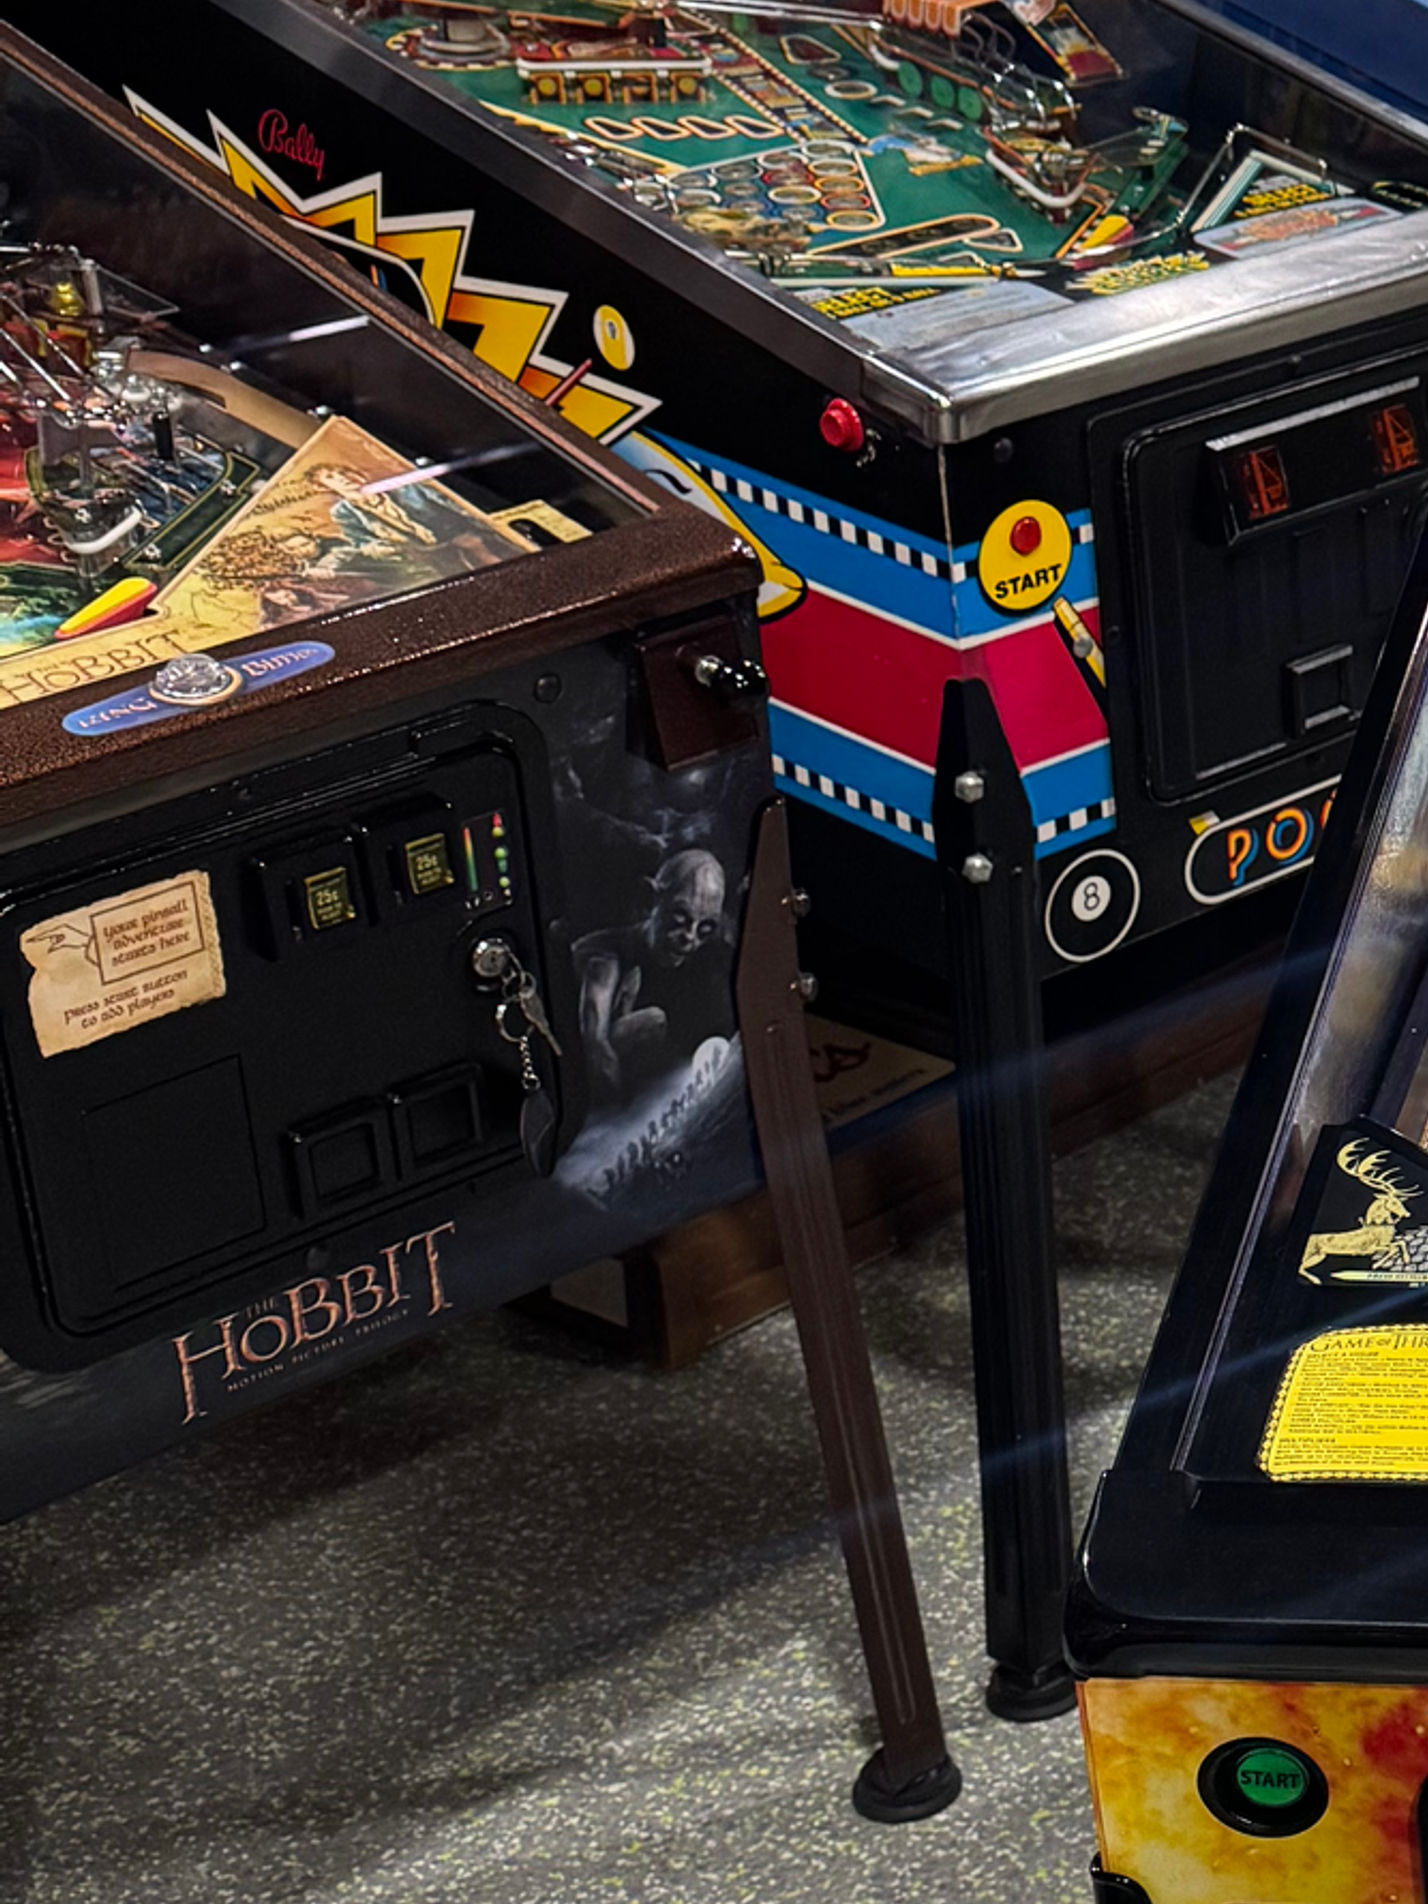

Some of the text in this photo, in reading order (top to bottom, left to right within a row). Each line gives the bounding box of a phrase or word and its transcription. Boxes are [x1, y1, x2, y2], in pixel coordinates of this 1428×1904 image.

[258, 108, 325, 181] Bally
[995, 563, 1063, 599] START
[0, 630, 187, 703] HOBBIT
[1084, 882, 1100, 911] 8
[172, 1221, 456, 1426] HOBBIT
[1310, 1337, 1374, 1353] GAME
[227, 1362, 285, 1393] MOTION
[291, 1336, 346, 1364] PICTURE
[1241, 1770, 1300, 1789] START
